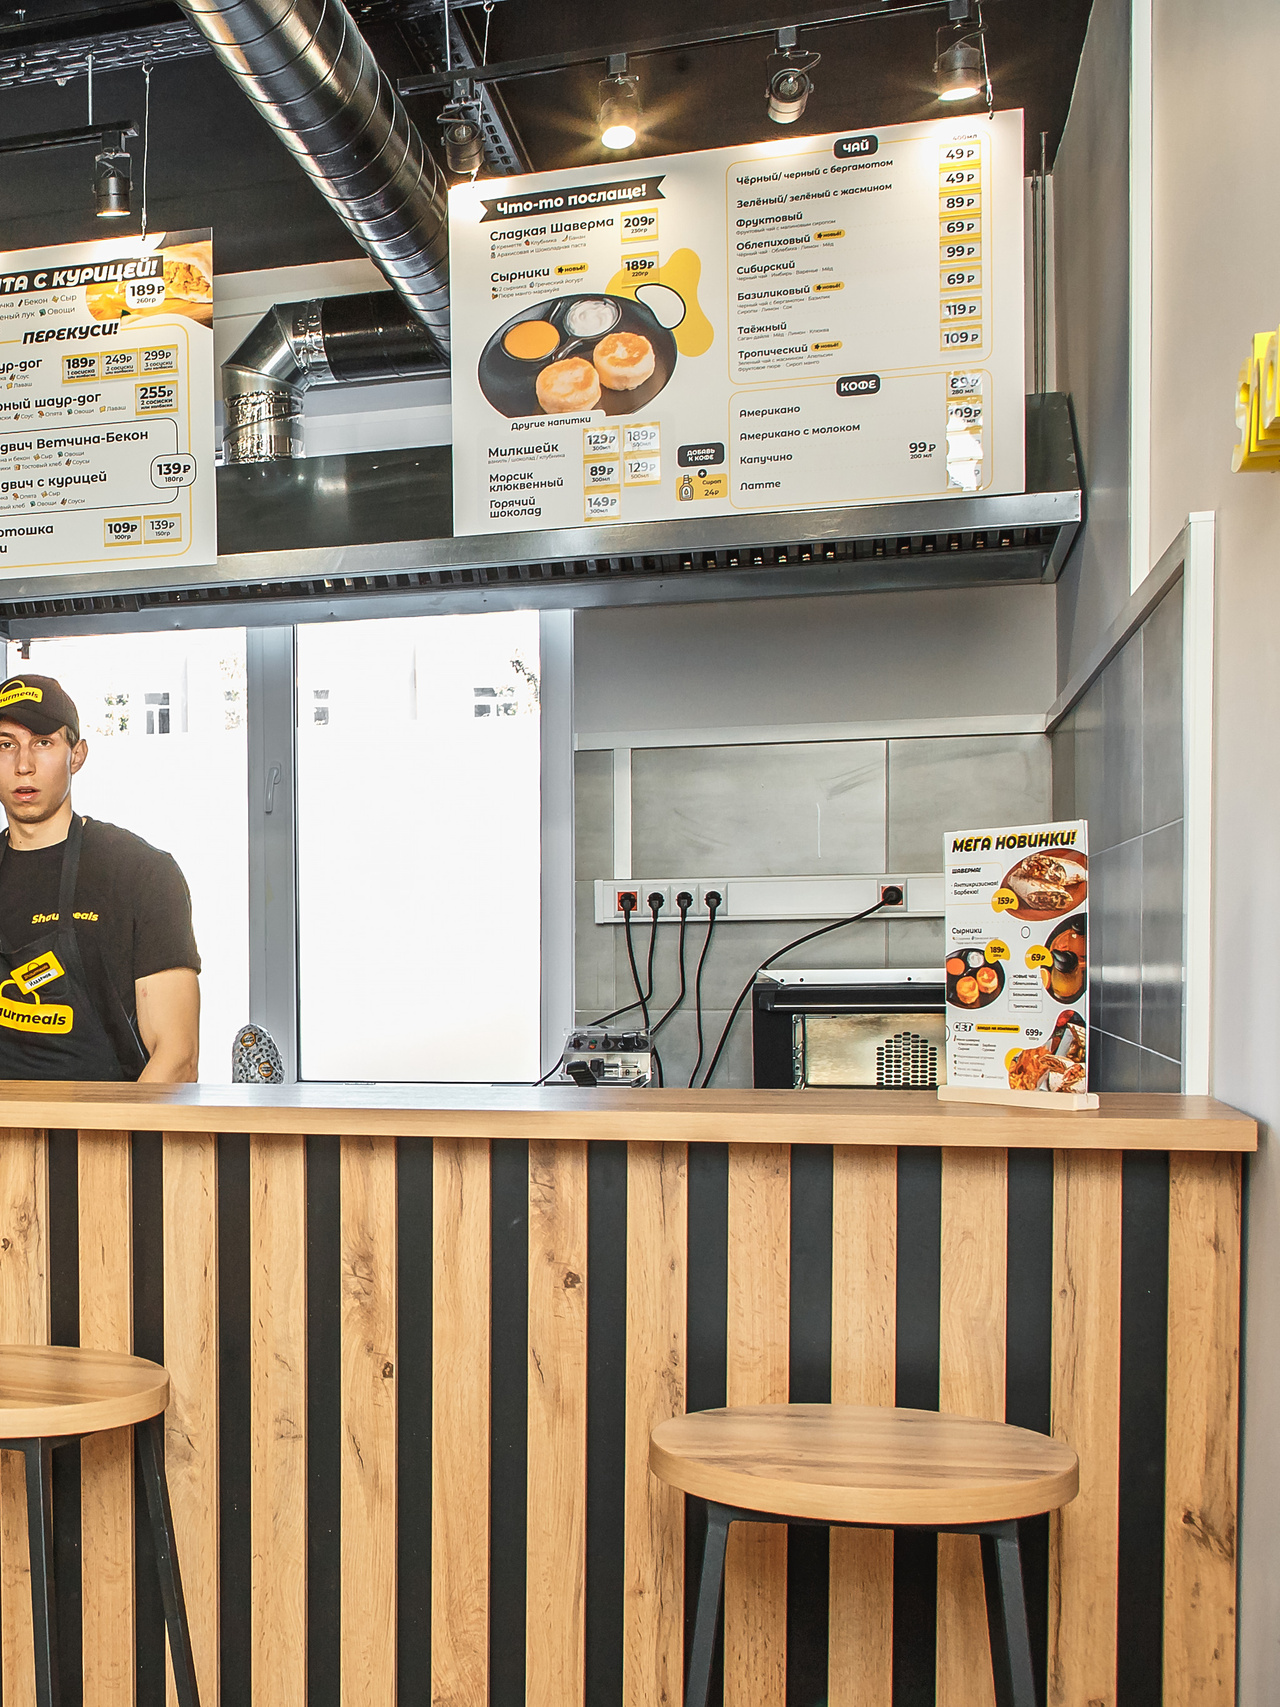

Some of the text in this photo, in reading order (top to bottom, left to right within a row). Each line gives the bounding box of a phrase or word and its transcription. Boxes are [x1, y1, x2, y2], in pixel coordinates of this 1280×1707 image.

[843, 139, 870, 152] ЧАЙ
[736, 172, 782, 185] Чёрный/
[784, 167, 820, 180] черный
[830, 159, 893, 174] бергамотом
[496, 183, 647, 215] Что-то послаще!
[736, 194, 787, 208] Зелёный/
[789, 190, 830, 202] зелёный
[840, 183, 892, 195] жасмином
[736, 211, 803, 228] Фруктовый
[490, 217, 614, 241] Сладкая Шаверма
[736, 235, 810, 250] Облепиховый
[34, 274, 47, 288] С
[52, 258, 158, 287] КУРИЦЕЙ!
[490, 267, 550, 283] Сырники
[737, 261, 795, 275] Сибирский
[737, 285, 810, 301] Базиликовый
[24, 297, 48, 306] Бекон
[23, 323, 119, 344] ПЕРЕКУСИ!
[737, 322, 787, 335] Таёжный
[738, 344, 808, 359] Тропический
[840, 379, 877, 392] КОФЕ
[35, 392, 101, 407] шаур-дог
[739, 405, 800, 418] Американо
[511, 416, 591, 431] Другие напитки
[740, 423, 860, 441] Американо с молоком
[37, 431, 148, 449] Ветчина-Бекон
[488, 442, 559, 458] Милкшейк
[687, 448, 716, 456] ДОБАВЬ
[740, 453, 793, 465] Капучино
[38, 478, 44, 487] с
[49, 472, 107, 486] курицей
[489, 472, 533, 483] Морсик
[489, 478, 564, 493] клюквенный
[740, 480, 781, 491] Латте
[490, 496, 536, 510] Горячий
[490, 506, 542, 519] шоколад
[952, 831, 1077, 852] МЕГА НОВИНКИ!
[32, 912, 99, 924] Shaueals
